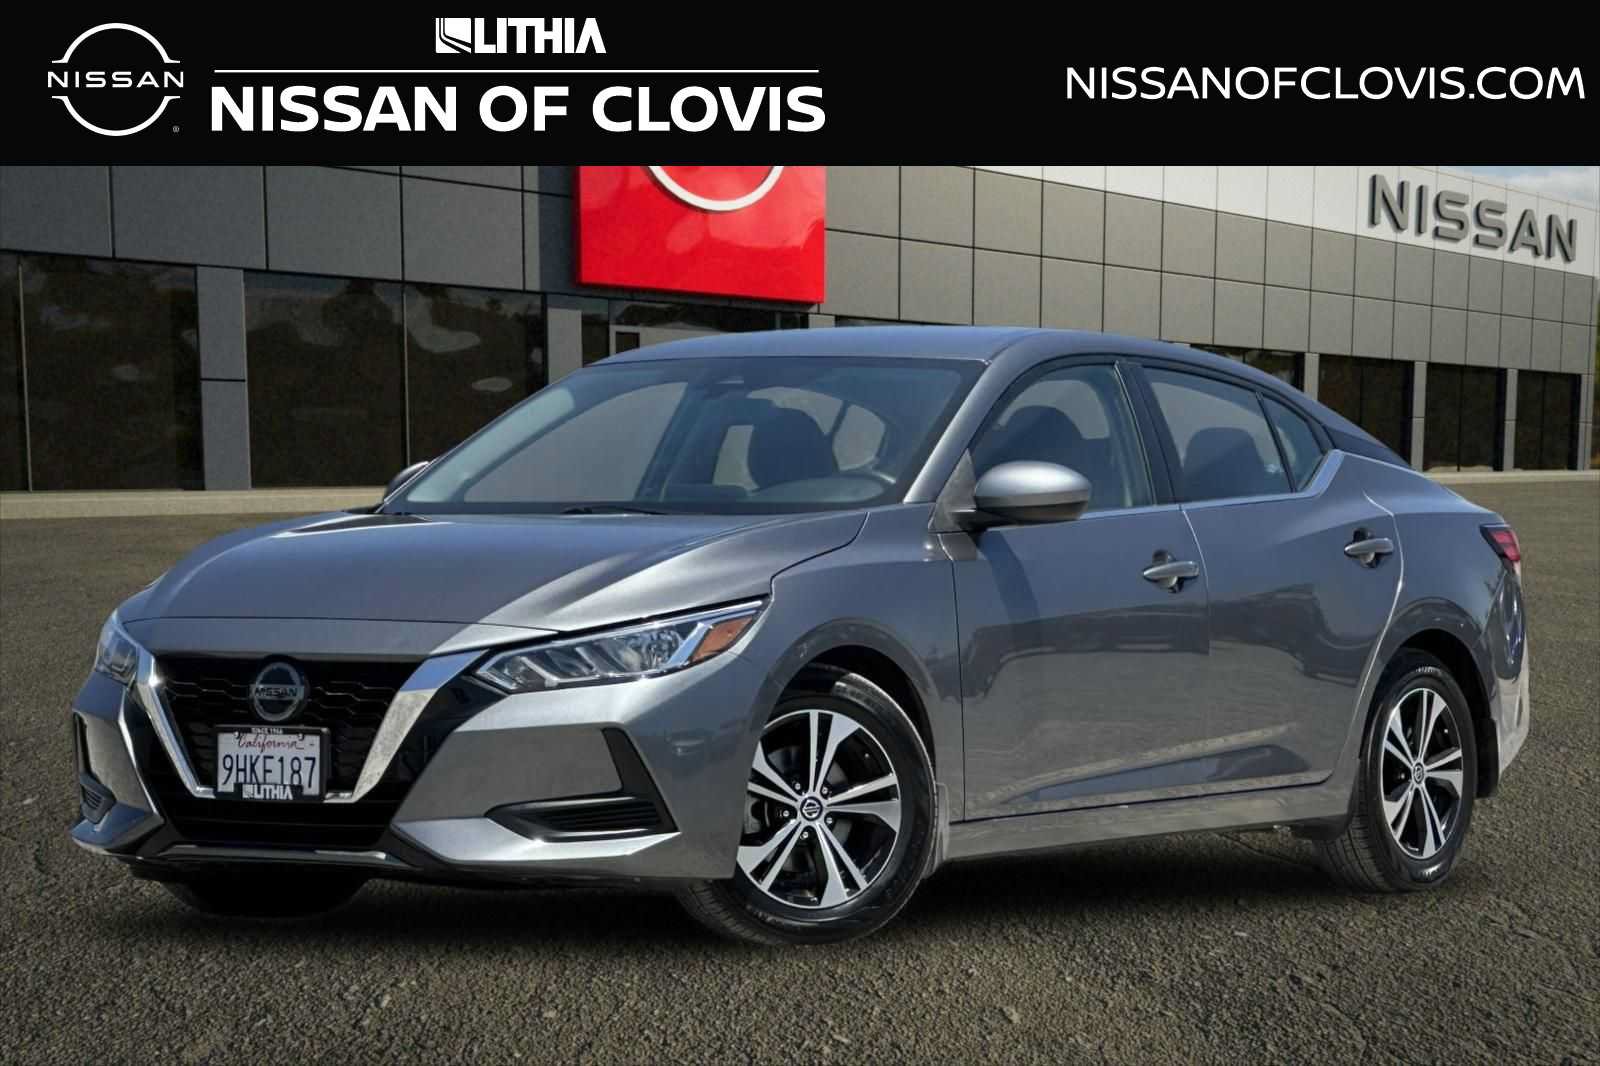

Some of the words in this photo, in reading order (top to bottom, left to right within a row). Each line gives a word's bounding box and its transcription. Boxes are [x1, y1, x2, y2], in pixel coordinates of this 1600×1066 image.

[1368, 173, 1578, 263] NISSAN
[238, 733, 304, 753] California
[254, 784, 293, 800] LITHIA
